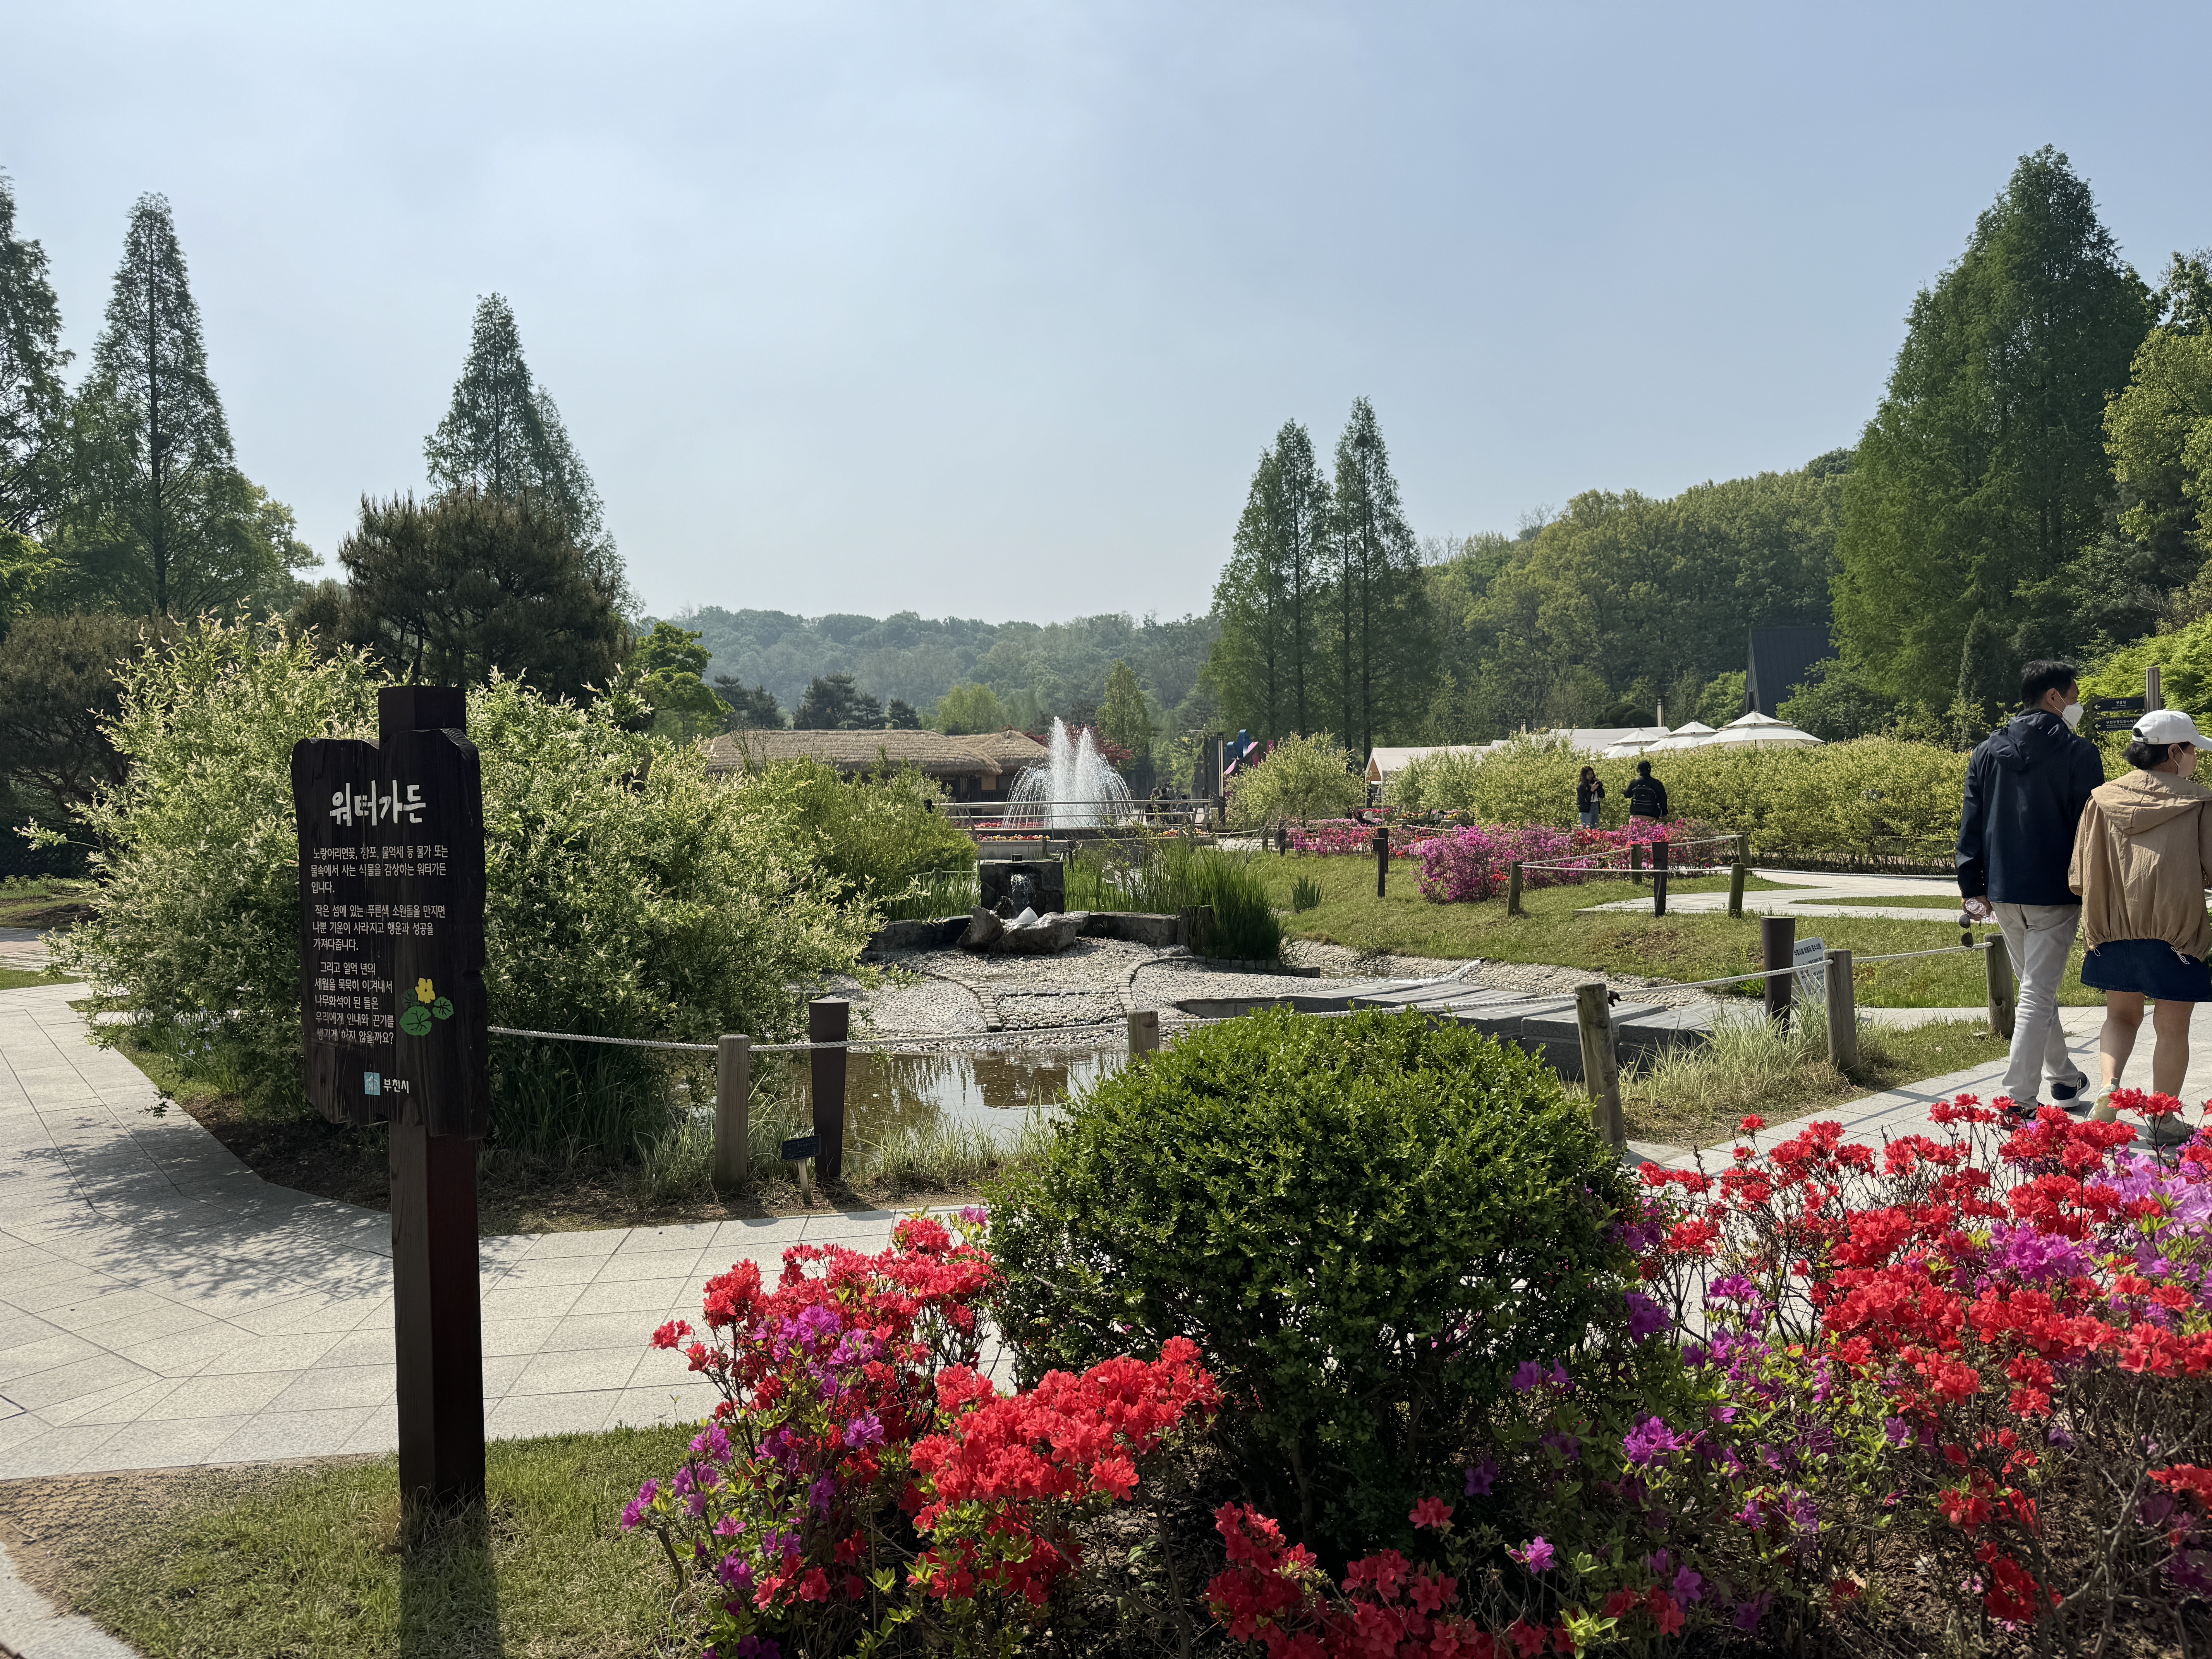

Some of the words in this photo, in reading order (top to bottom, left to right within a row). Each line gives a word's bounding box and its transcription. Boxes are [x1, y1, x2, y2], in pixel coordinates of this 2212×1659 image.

[330, 780, 426, 826] 워터가든
[313, 847, 357, 860] 노랑어리연꽃,
[382, 845, 404, 859] 물억새
[407, 846, 414, 859] 등
[416, 845, 431, 858] 물가
[434, 845, 448, 858] 또는
[311, 864, 338, 877] 물속에서
[341, 864, 356, 877] 사는
[359, 863, 381, 876] 식물을
[384, 863, 414, 876] 감상하는
[417, 862, 446, 876] 워터가든
[311, 881, 335, 894] 입니다.
[315, 904, 330, 917] 작은
[332, 904, 347, 917] 섬에
[350, 904, 364, 917] 있는
[367, 904, 389, 917] 푸른색
[392, 905, 420, 918] 소원돌을
[423, 905, 445, 918] 만지면
[313, 921, 327, 934] 나뿐
[330, 921, 350, 934] 기운이
[353, 921, 385, 934] 사라지고
[387, 922, 410, 935] 행운과
[412, 922, 434, 936] 성공을
[313, 938, 359, 951] 가져다줍니다.
[320, 961, 340, 974] 그리고
[343, 962, 357, 975] 일억
[360, 962, 376, 975] 년의
[314, 977, 336, 991] 세월을
[338, 979, 359, 992] 묵묵히
[362, 979, 392, 993] 이겨내서
[315, 994, 350, 1008] 나무화석이
[353, 996, 361, 1009] 된
[364, 997, 379, 1010] 돌은
[316, 1011, 344, 1025] 우리에게
[347, 1013, 369, 1026] 인내와
[372, 1014, 394, 1028] 끈기를
[317, 1028, 338, 1041] 생기게
[341, 1029, 356, 1041] 하지
[359, 1030, 394, 1044] 않을까요?
[383, 1078, 409, 1094] 부천시
